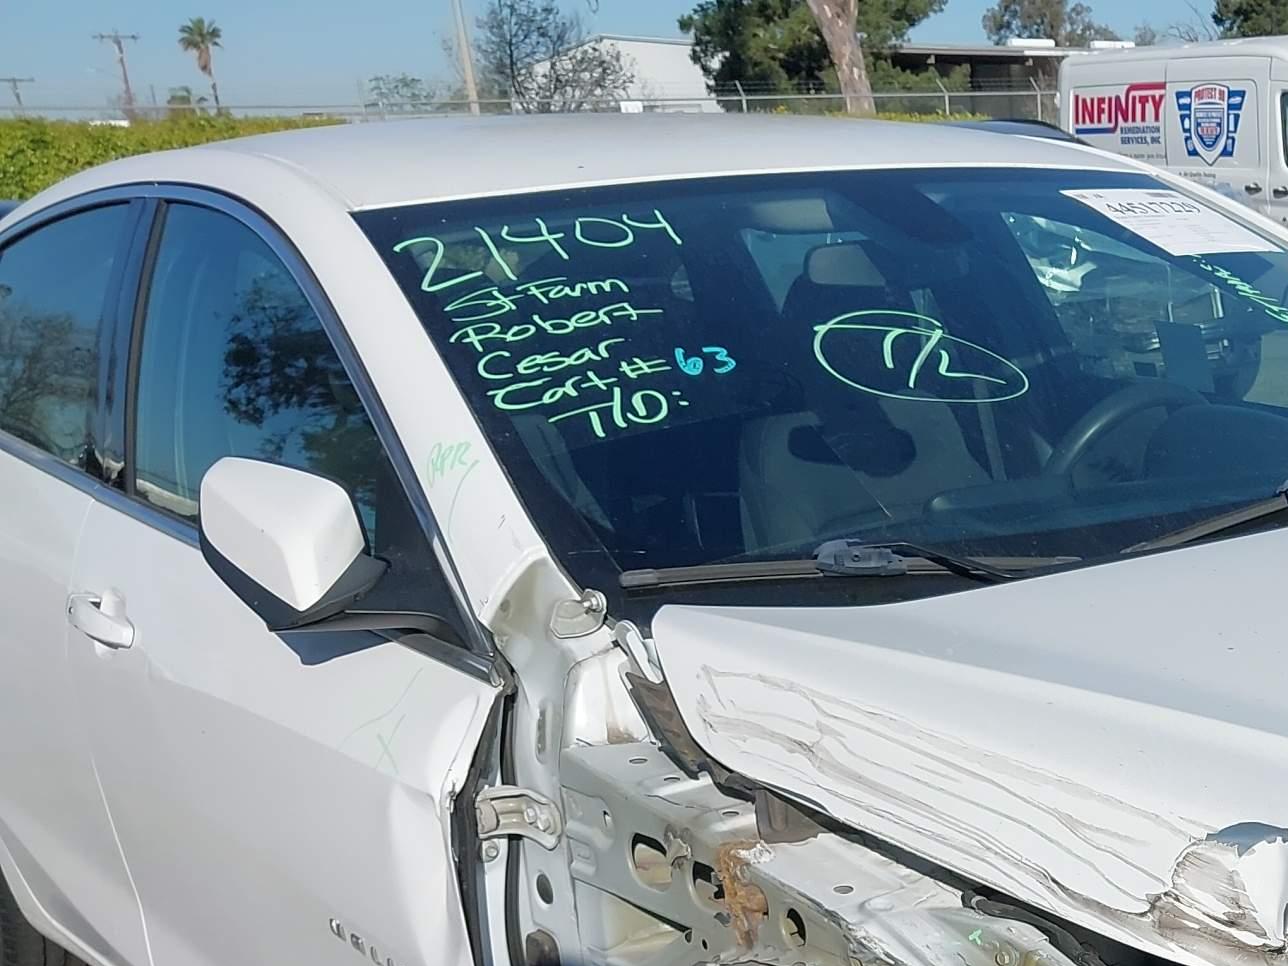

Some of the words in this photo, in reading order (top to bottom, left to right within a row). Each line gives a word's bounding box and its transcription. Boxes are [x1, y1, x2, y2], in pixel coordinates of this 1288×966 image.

[1075, 93, 1165, 124] INFINITY
[1105, 201, 1201, 215] 44517229
[393, 208, 682, 292] 21404
[449, 302, 664, 352] Robert
[478, 338, 626, 380] Cesar
